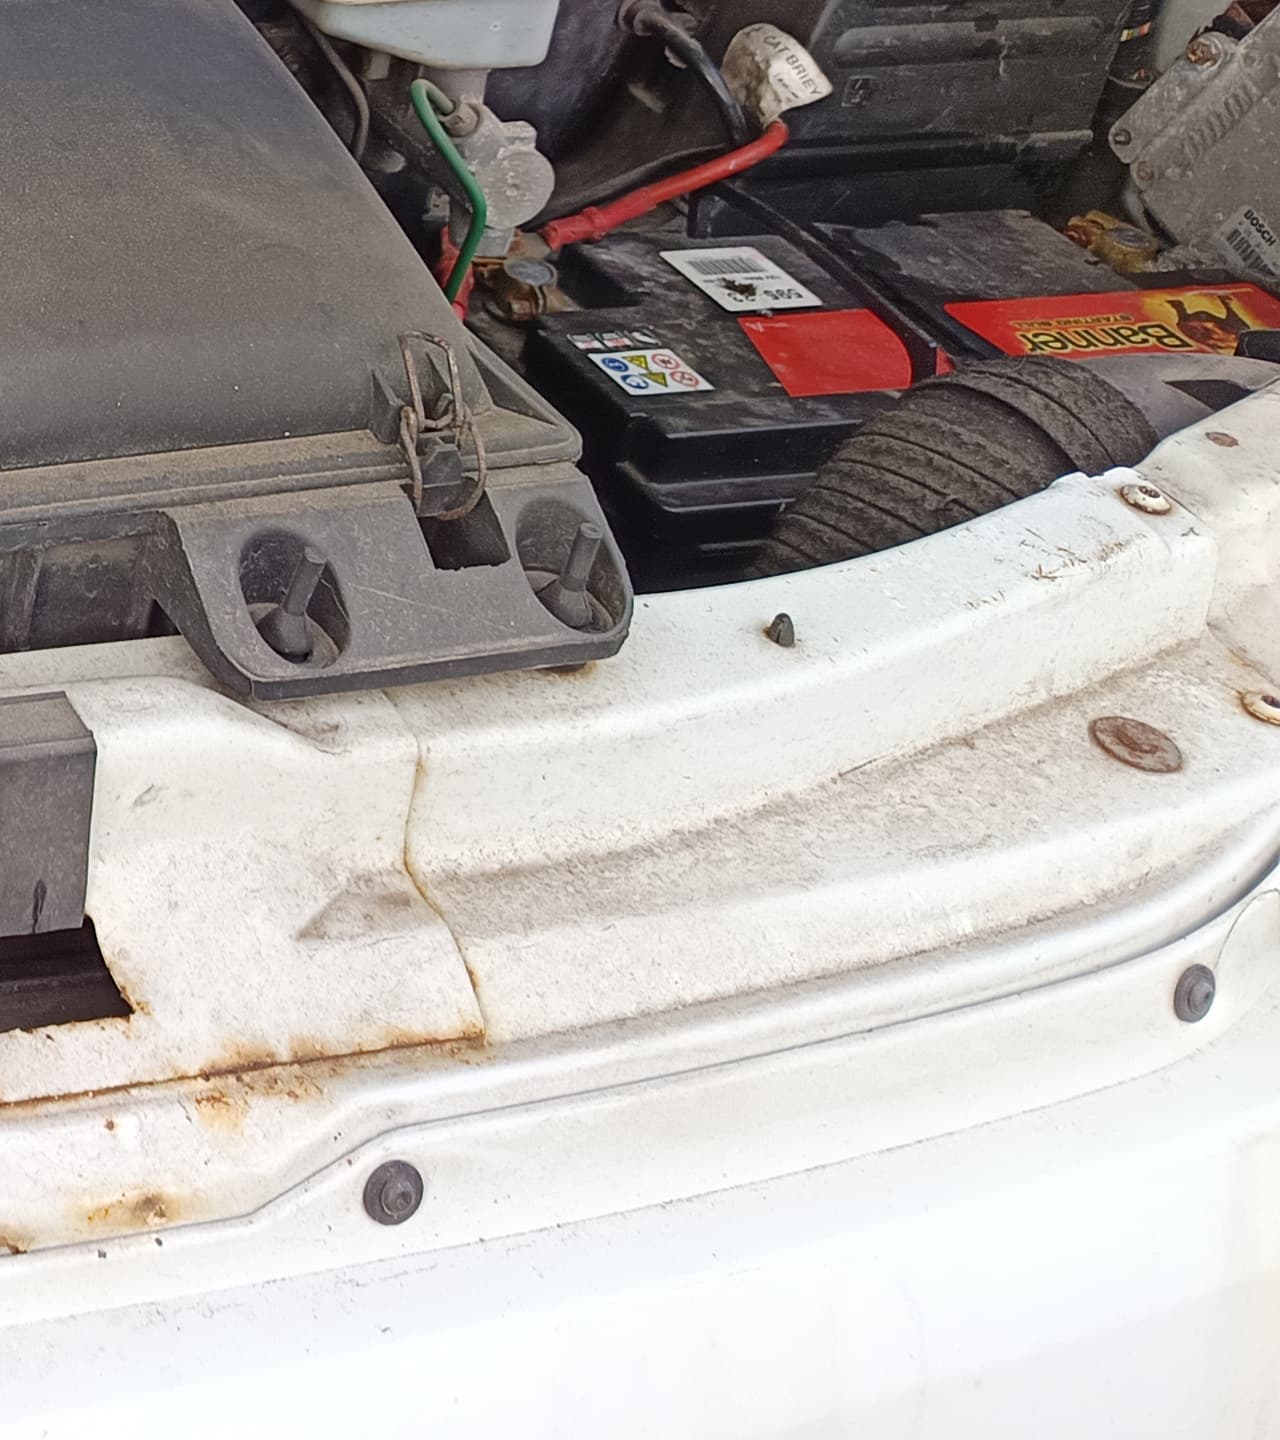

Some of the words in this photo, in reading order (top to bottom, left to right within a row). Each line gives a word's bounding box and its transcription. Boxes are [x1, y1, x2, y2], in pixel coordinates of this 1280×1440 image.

[785, 54, 822, 96] BRIEY
[1243, 208, 1276, 247] BOSCH
[1012, 319, 1052, 328] BULL
[1056, 314, 1132, 327] STARTING
[1021, 323, 1189, 353] Banner
